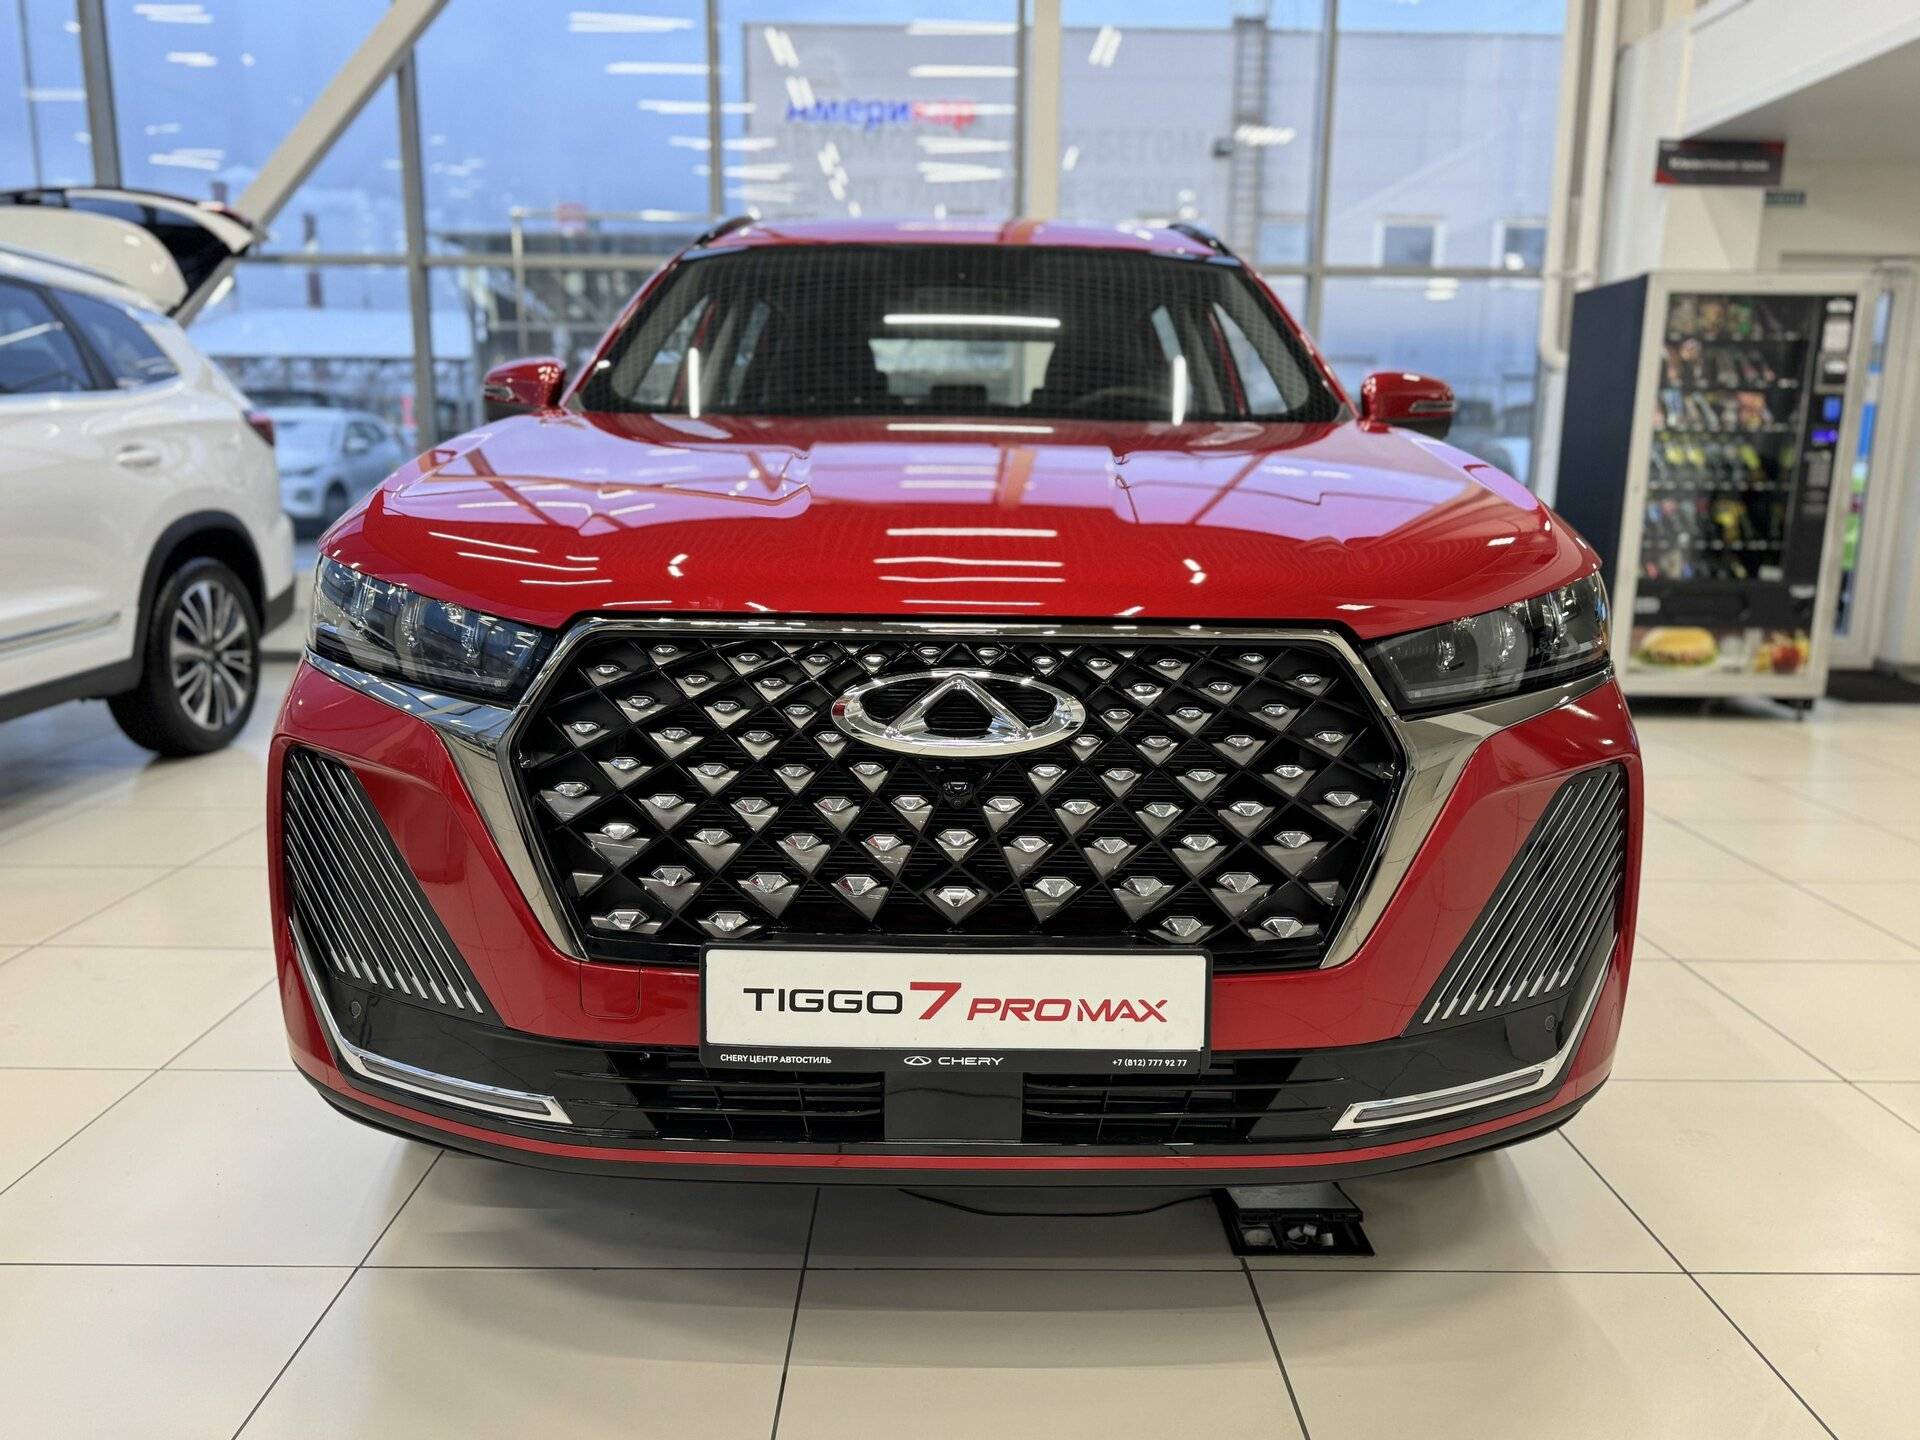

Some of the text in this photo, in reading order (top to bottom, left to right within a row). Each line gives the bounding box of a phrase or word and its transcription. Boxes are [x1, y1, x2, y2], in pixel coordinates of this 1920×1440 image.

[743, 981, 1169, 1023] TIGGO 7 PRO MAX
[720, 1053, 832, 1064] CHERY ЦЕНТР АВТОСТИЛЬ
[938, 1056, 1004, 1066] CHERY
[1124, 1058, 1146, 1067] (812)
[1147, 1059, 1163, 1067] 777
[1164, 1059, 1175, 1067] 92
[1177, 1059, 1187, 1067] 77
